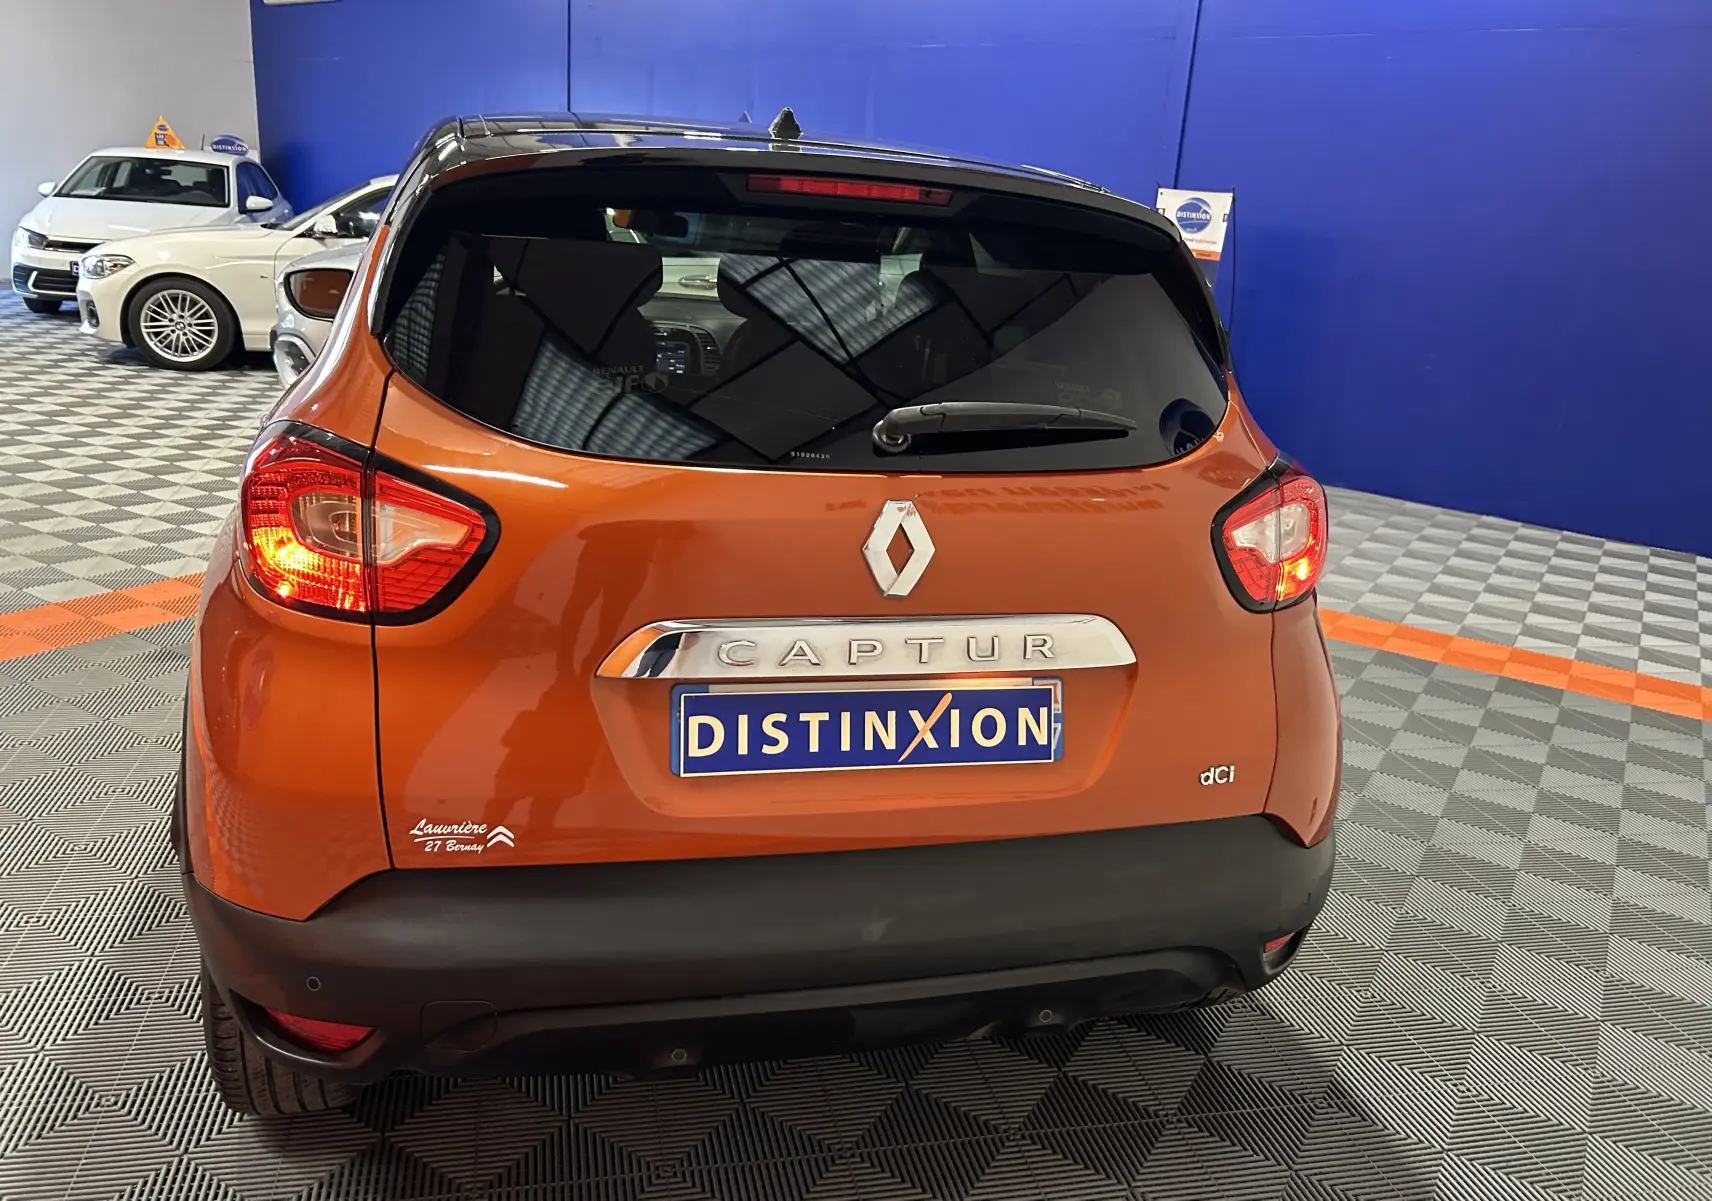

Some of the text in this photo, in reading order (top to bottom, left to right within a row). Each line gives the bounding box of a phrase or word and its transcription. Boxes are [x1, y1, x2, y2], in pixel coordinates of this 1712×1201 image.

[592, 365, 645, 375] RENAULT
[717, 634, 1056, 667] CAPTUR
[687, 692, 1049, 762] DISTINXION
[1199, 765, 1235, 786] dCi
[408, 818, 488, 836] Lauvrière
[424, 840, 485, 854] 27 Bernay
